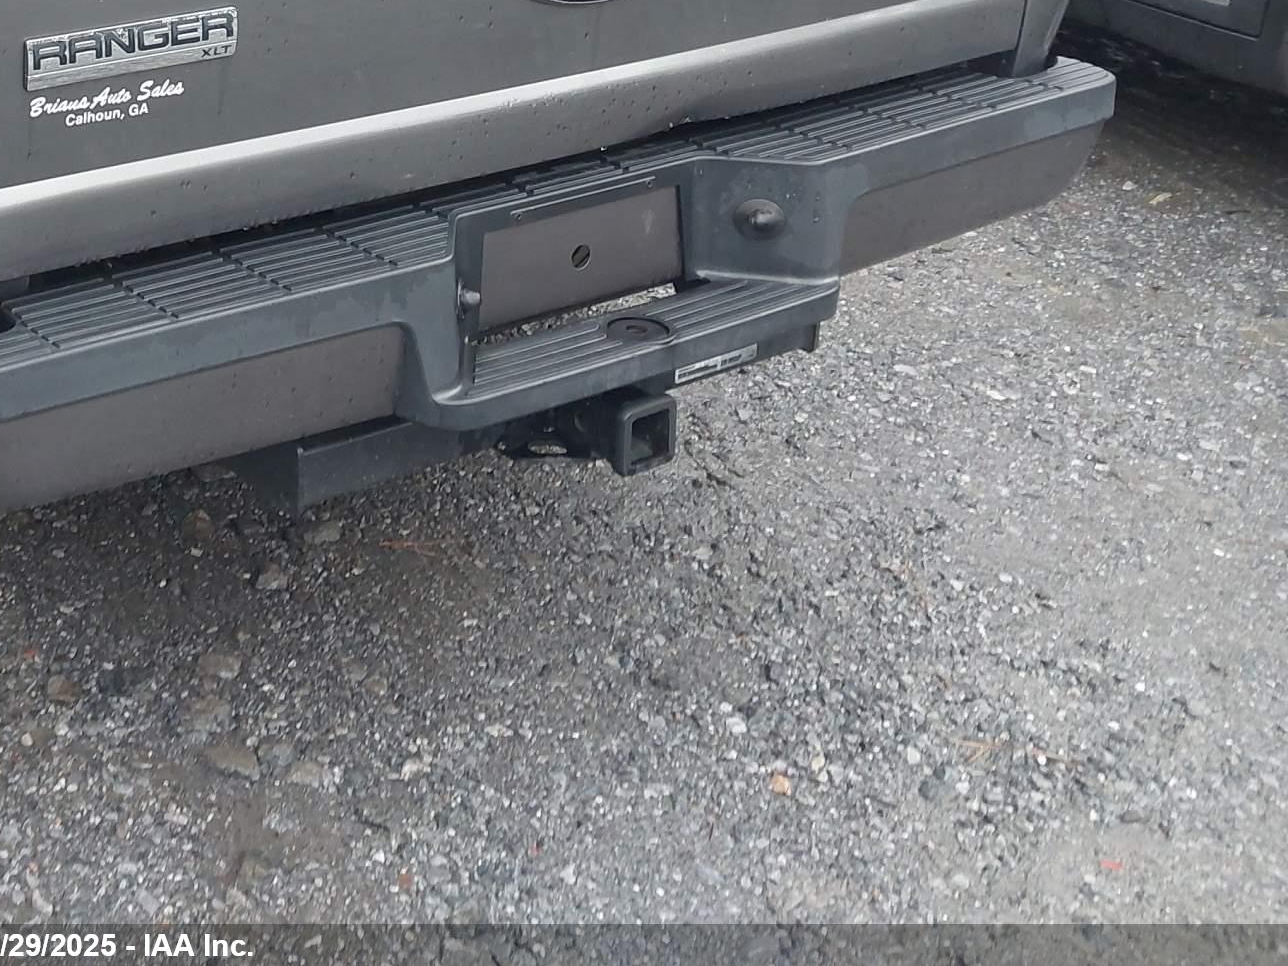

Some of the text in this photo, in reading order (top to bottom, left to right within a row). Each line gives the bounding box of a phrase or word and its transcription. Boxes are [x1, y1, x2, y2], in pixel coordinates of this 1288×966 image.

[31, 11, 235, 71] RANGER
[200, 44, 233, 59] XLT
[88, 85, 132, 109] Auto
[136, 79, 185, 101] Sales
[65, 102, 149, 127] Calhoun, GA
